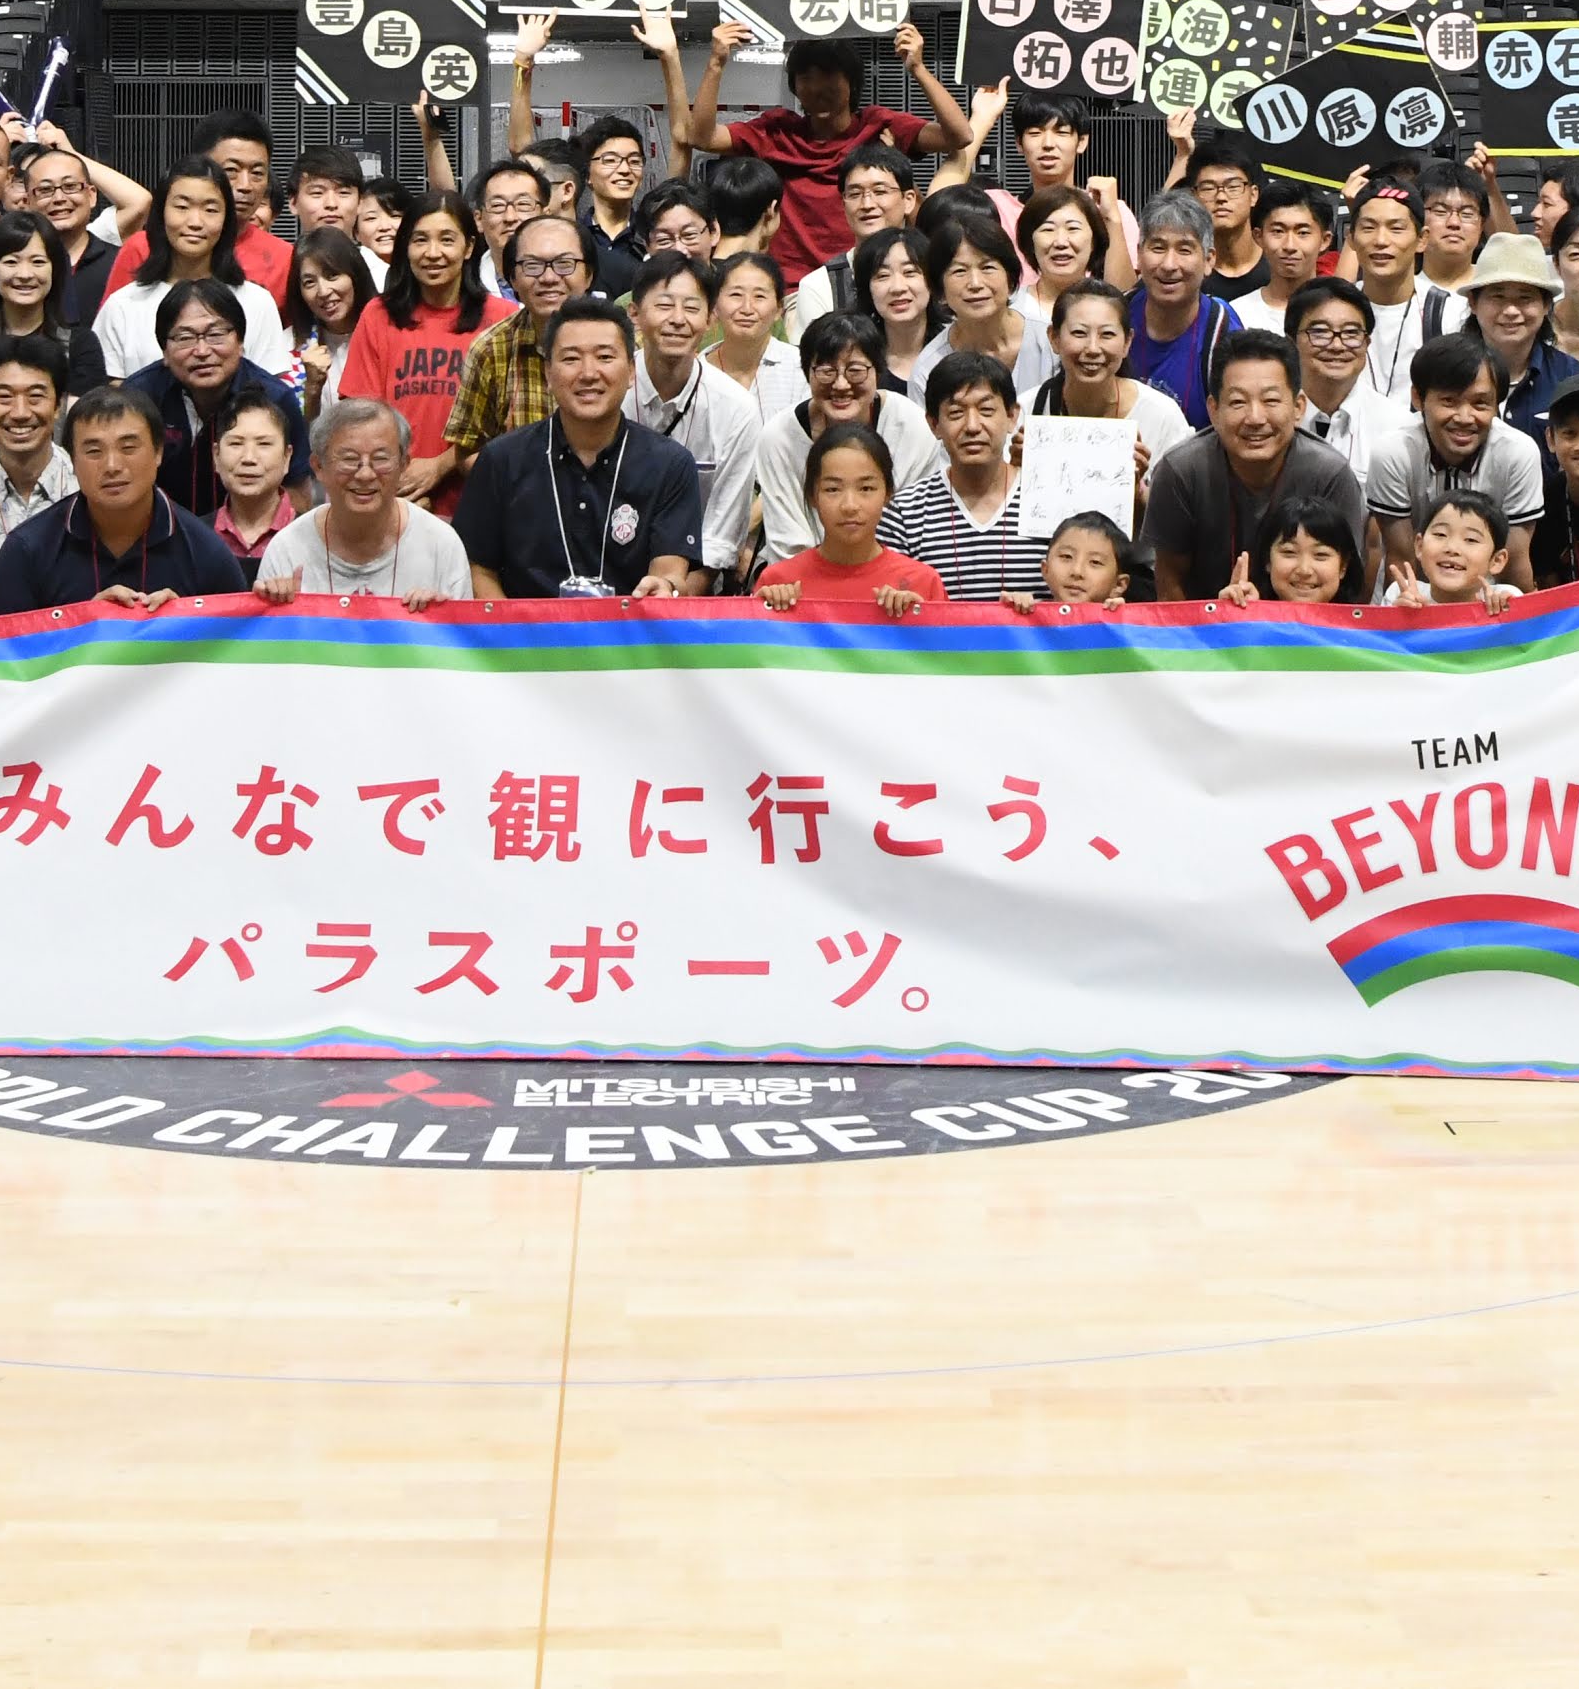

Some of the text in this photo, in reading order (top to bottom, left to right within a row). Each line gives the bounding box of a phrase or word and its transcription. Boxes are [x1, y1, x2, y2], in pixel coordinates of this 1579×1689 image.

[1024, 39, 1133, 90] 拓也
[1254, 90, 1438, 145] 川原凛
[395, 348, 465, 382] JAPA
[1411, 731, 1500, 770] TEAM
[161, 921, 930, 1014] パラスポーツ。
[512, 1091, 813, 1107] ELECTRIC
[515, 1077, 857, 1094] MITSUBISHI
[151, 1109, 908, 1163] CHALLENGE
[910, 1088, 1130, 1141] CUP
